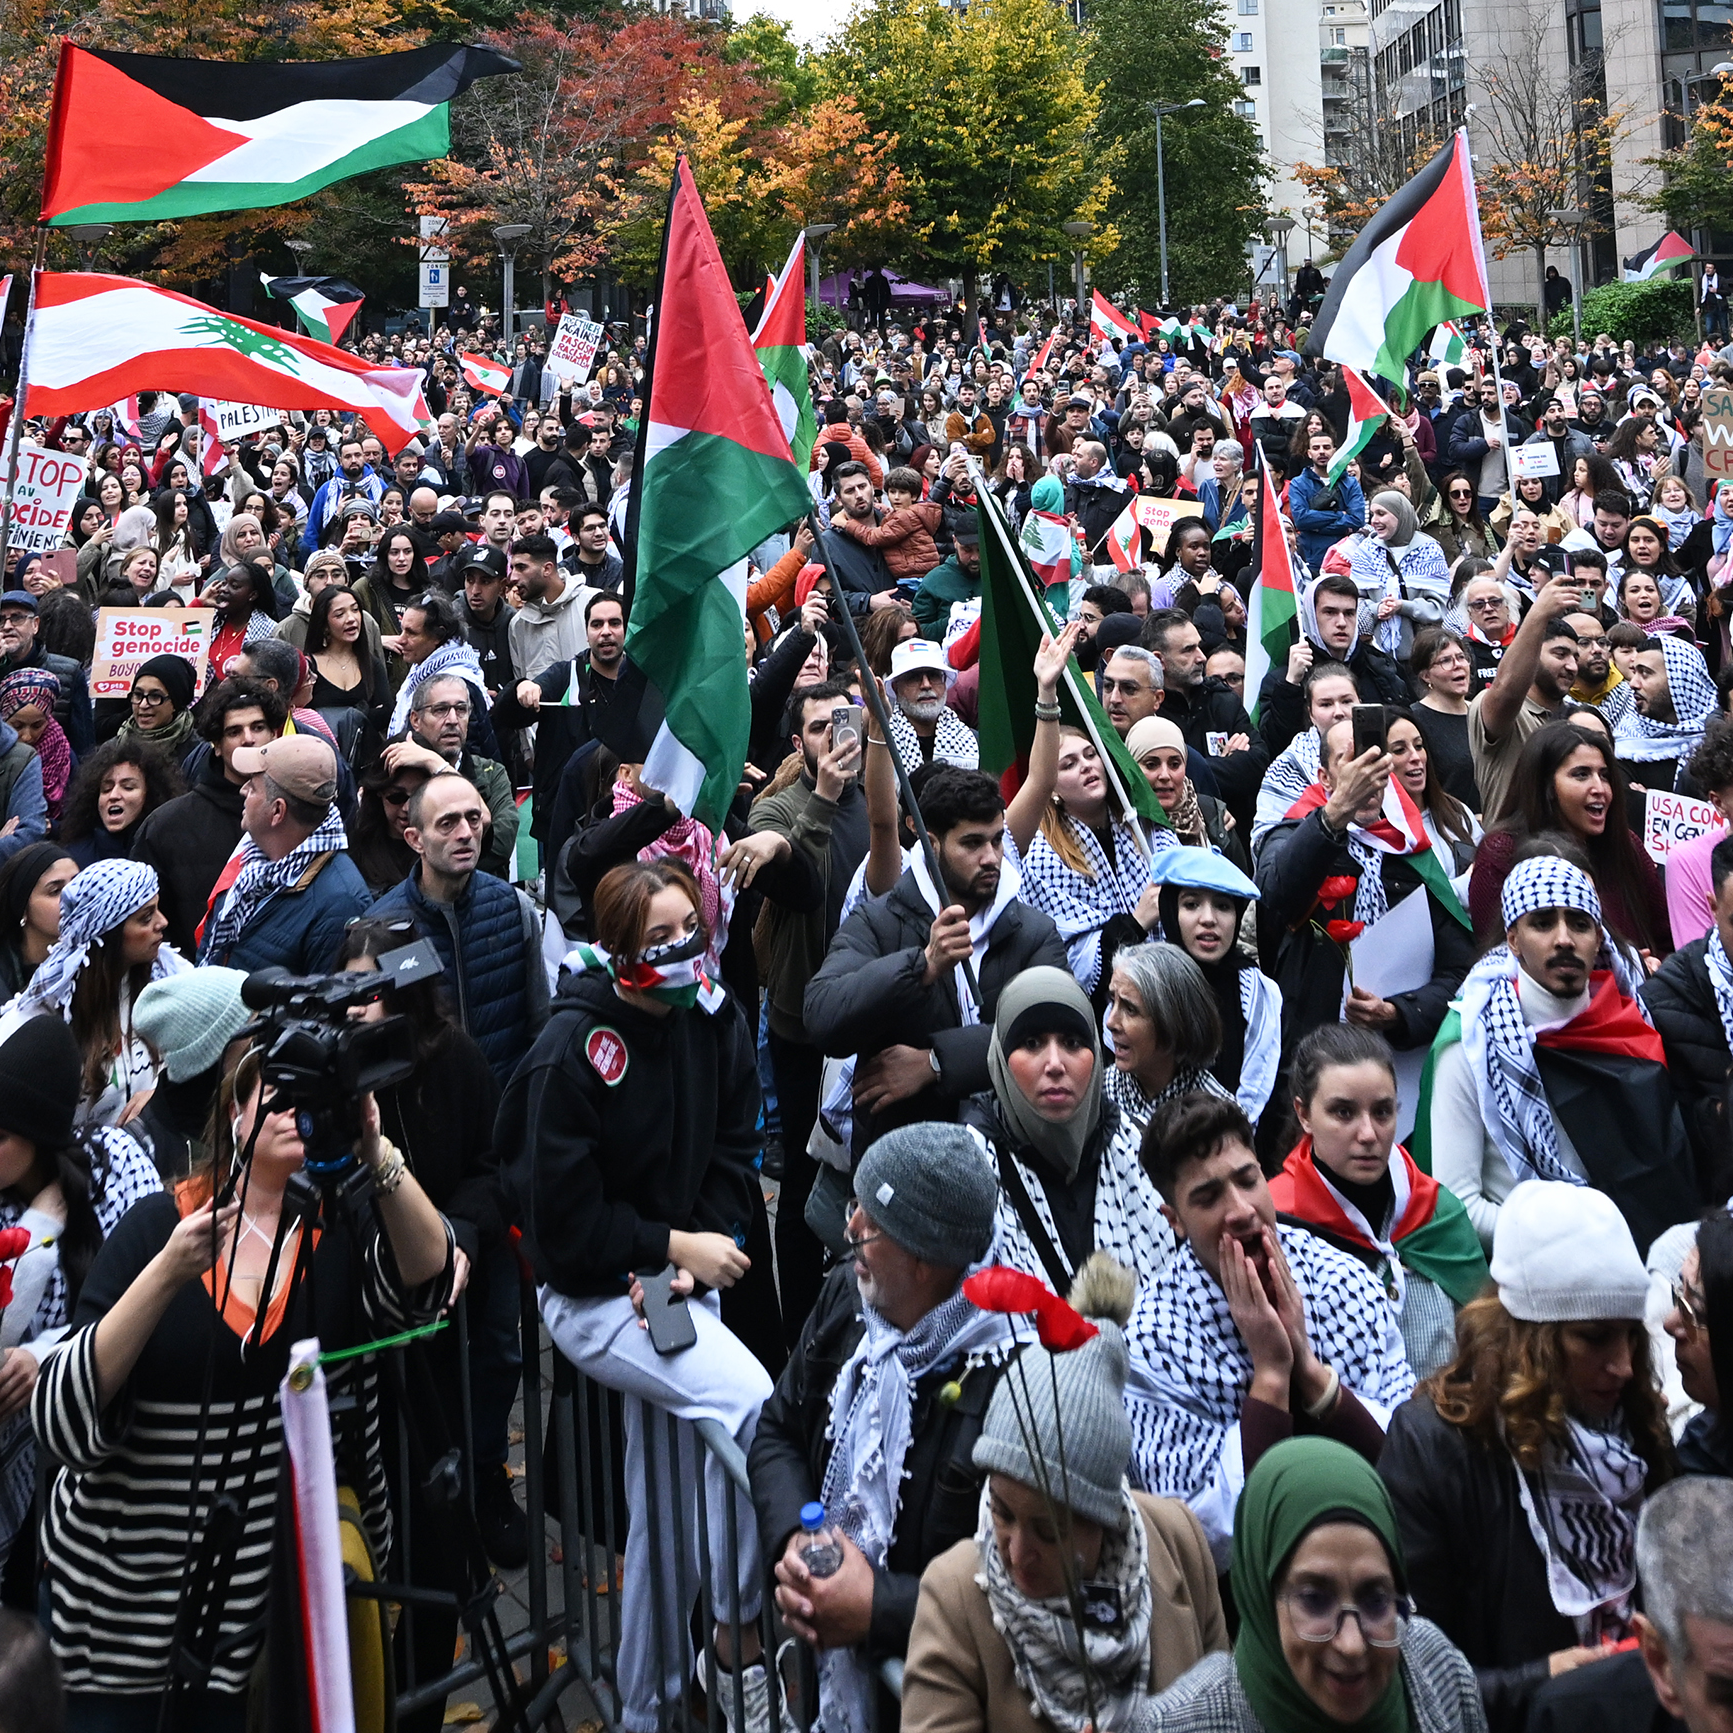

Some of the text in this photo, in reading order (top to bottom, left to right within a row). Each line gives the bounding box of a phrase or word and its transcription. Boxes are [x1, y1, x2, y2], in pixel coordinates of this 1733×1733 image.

[560, 323, 599, 345] AGAINST
[563, 316, 601, 334] TOGETHER
[558, 342, 591, 363] RACISM
[561, 334, 595, 356] FASCISM
[0, 452, 83, 497] STOP
[1145, 506, 1170, 519] Stop
[114, 621, 162, 640] Stop
[112, 636, 200, 657] genocide
[1652, 796, 1684, 821] USA
[1652, 817, 1670, 834] EN
